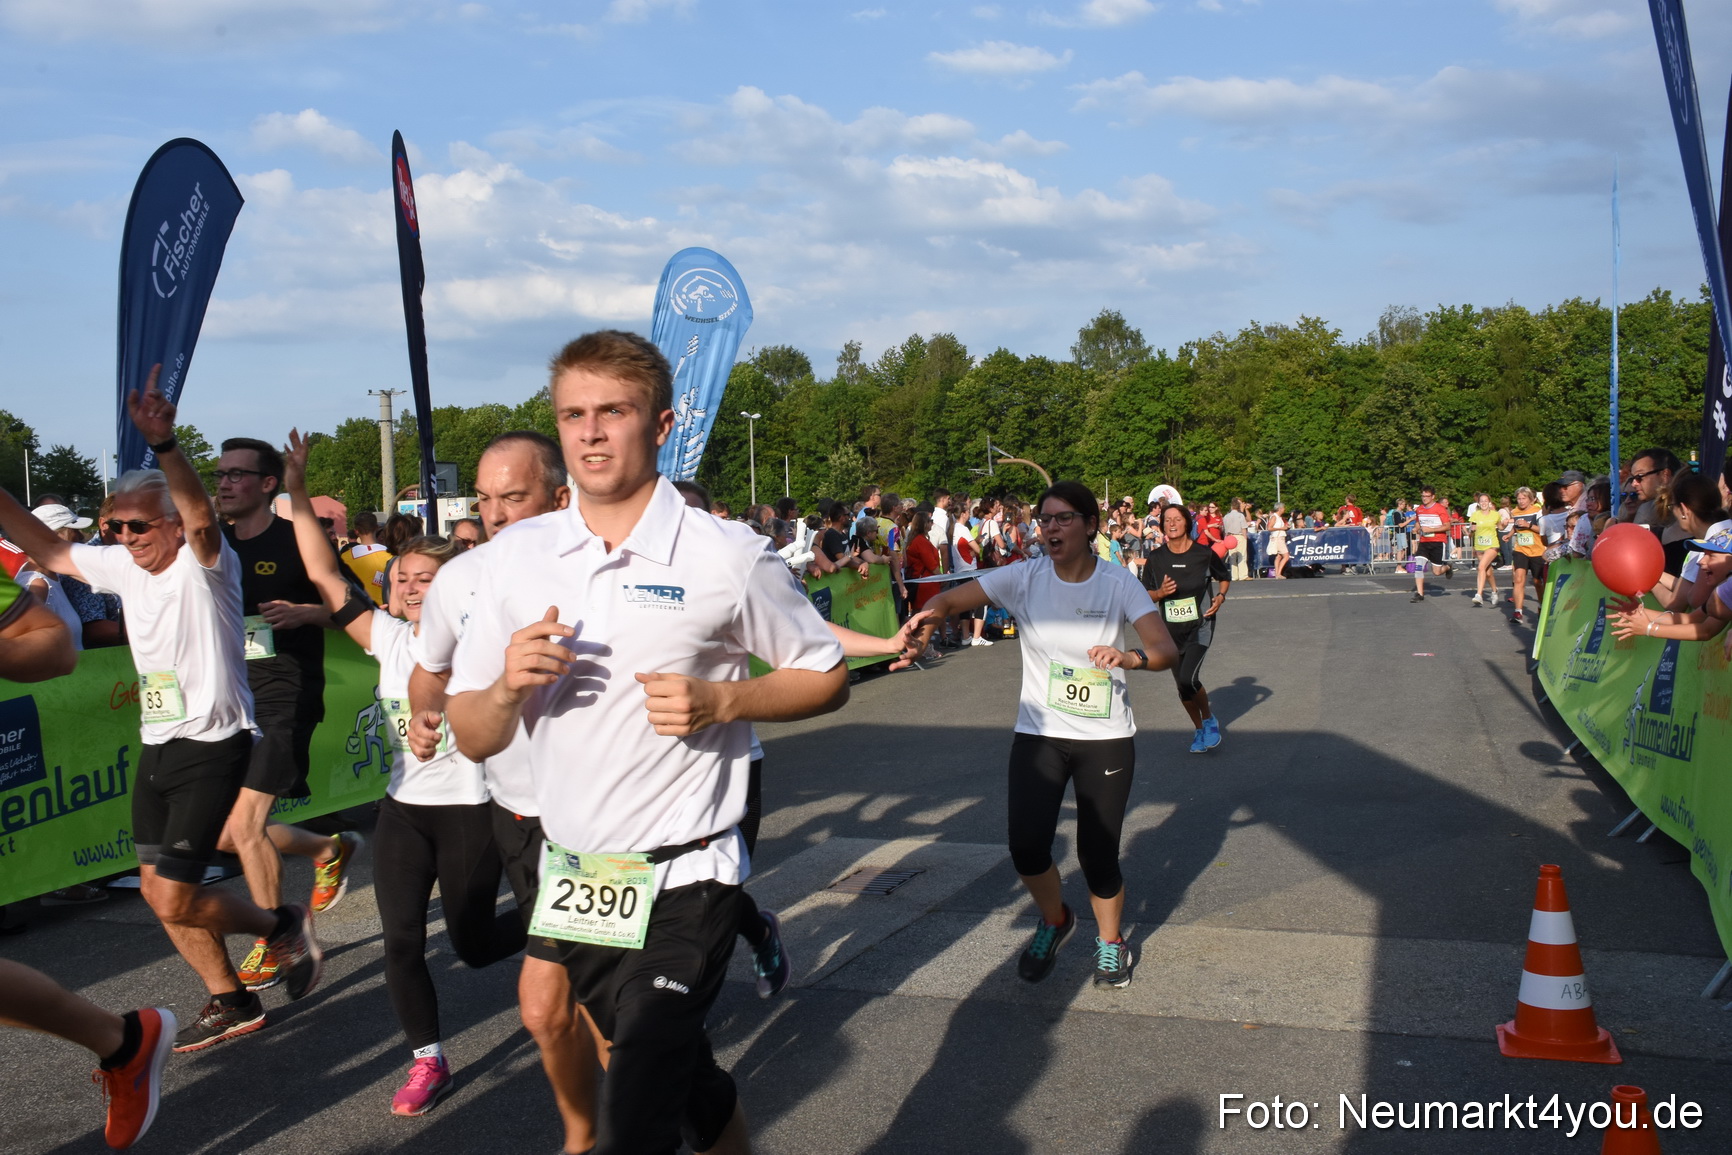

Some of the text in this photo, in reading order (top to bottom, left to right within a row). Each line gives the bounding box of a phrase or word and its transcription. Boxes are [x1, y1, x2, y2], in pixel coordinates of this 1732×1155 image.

[163, 181, 204, 281] Fischer
[180, 201, 210, 280] AUTOMOBILE
[1294, 543, 1349, 556] Fischer
[1168, 606, 1193, 617] 1984
[146, 690, 163, 709] 83
[1066, 684, 1091, 703] 90
[398, 718, 412, 737] 8
[550, 878, 637, 919] 2390
[567, 915, 616, 929] Leitner Tim
